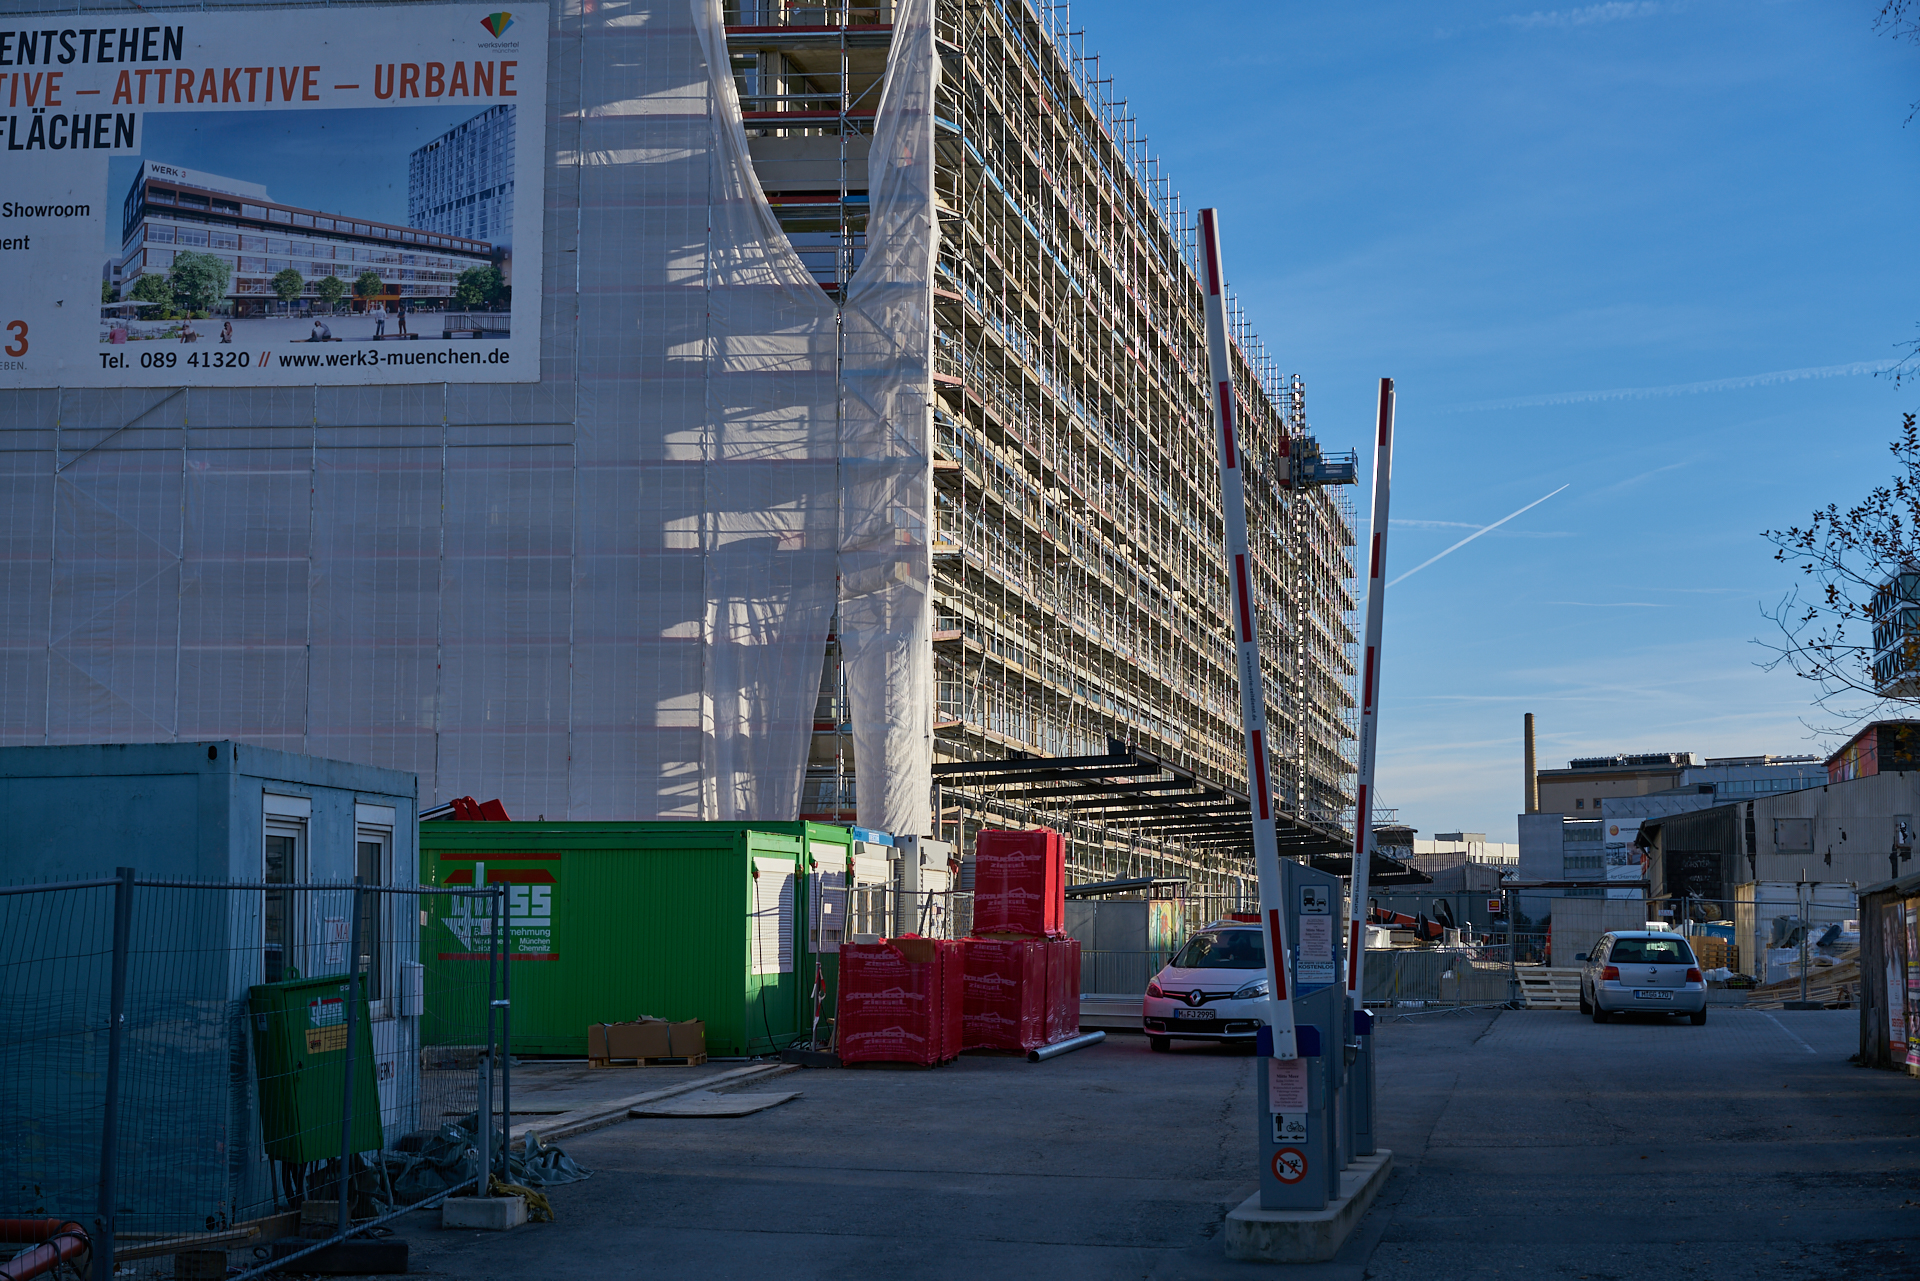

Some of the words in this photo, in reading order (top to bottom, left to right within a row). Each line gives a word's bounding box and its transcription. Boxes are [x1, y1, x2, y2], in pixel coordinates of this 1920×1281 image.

[0, 26, 183, 66] ENTSTEHEN
[477, 40, 520, 50] werksviertel
[112, 66, 321, 105] ATTRAKTIVE
[374, 61, 518, 100] URBANE
[151, 164, 179, 177] WERK
[181, 170, 188, 179] 3
[2, 201, 90, 218] Showroom
[0, 235, 30, 250] ent
[4, 320, 29, 358] 3
[99, 353, 130, 369] Tel.
[140, 352, 177, 368] 089
[187, 351, 249, 368] 41320
[279, 348, 511, 368] www.werk3-muenchen.de
[518, 944, 551, 952] Chemnitz
[519, 937, 551, 945] München
[1197, 1011, 1214, 1019] 2995
